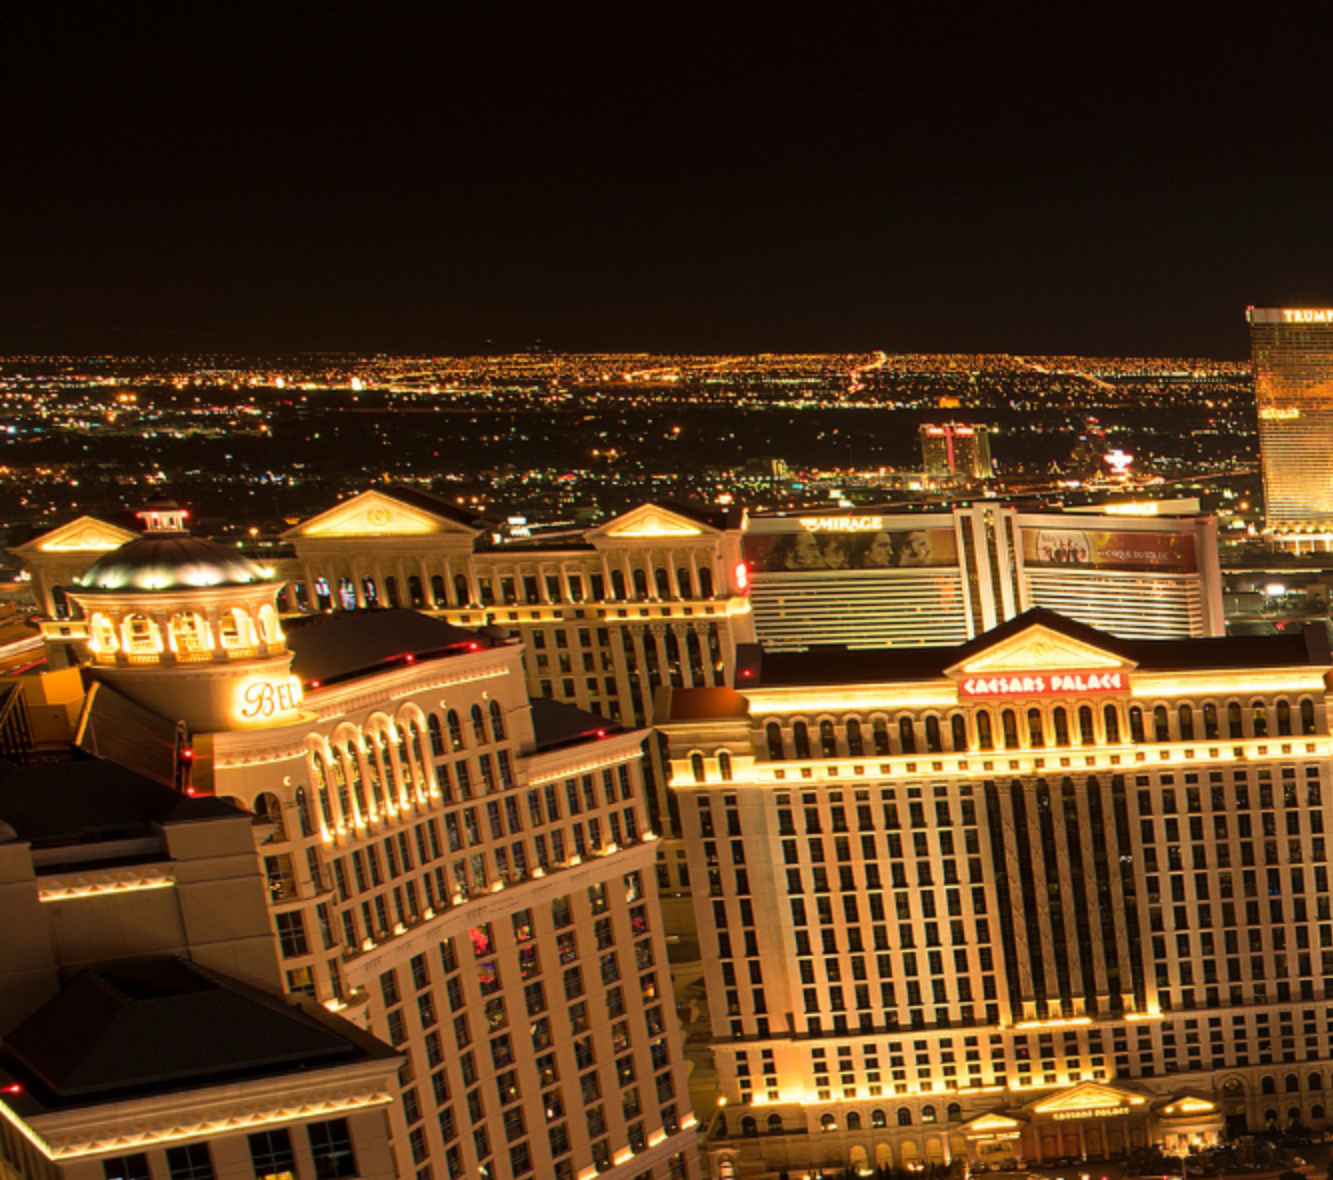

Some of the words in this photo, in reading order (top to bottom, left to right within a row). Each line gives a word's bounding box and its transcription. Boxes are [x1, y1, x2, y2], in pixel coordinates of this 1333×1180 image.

[1283, 309, 1333, 322] TRUMP
[818, 517, 883, 530] MIRAGE
[964, 678, 1045, 694] CAESARS
[1051, 673, 1122, 691] PALACE
